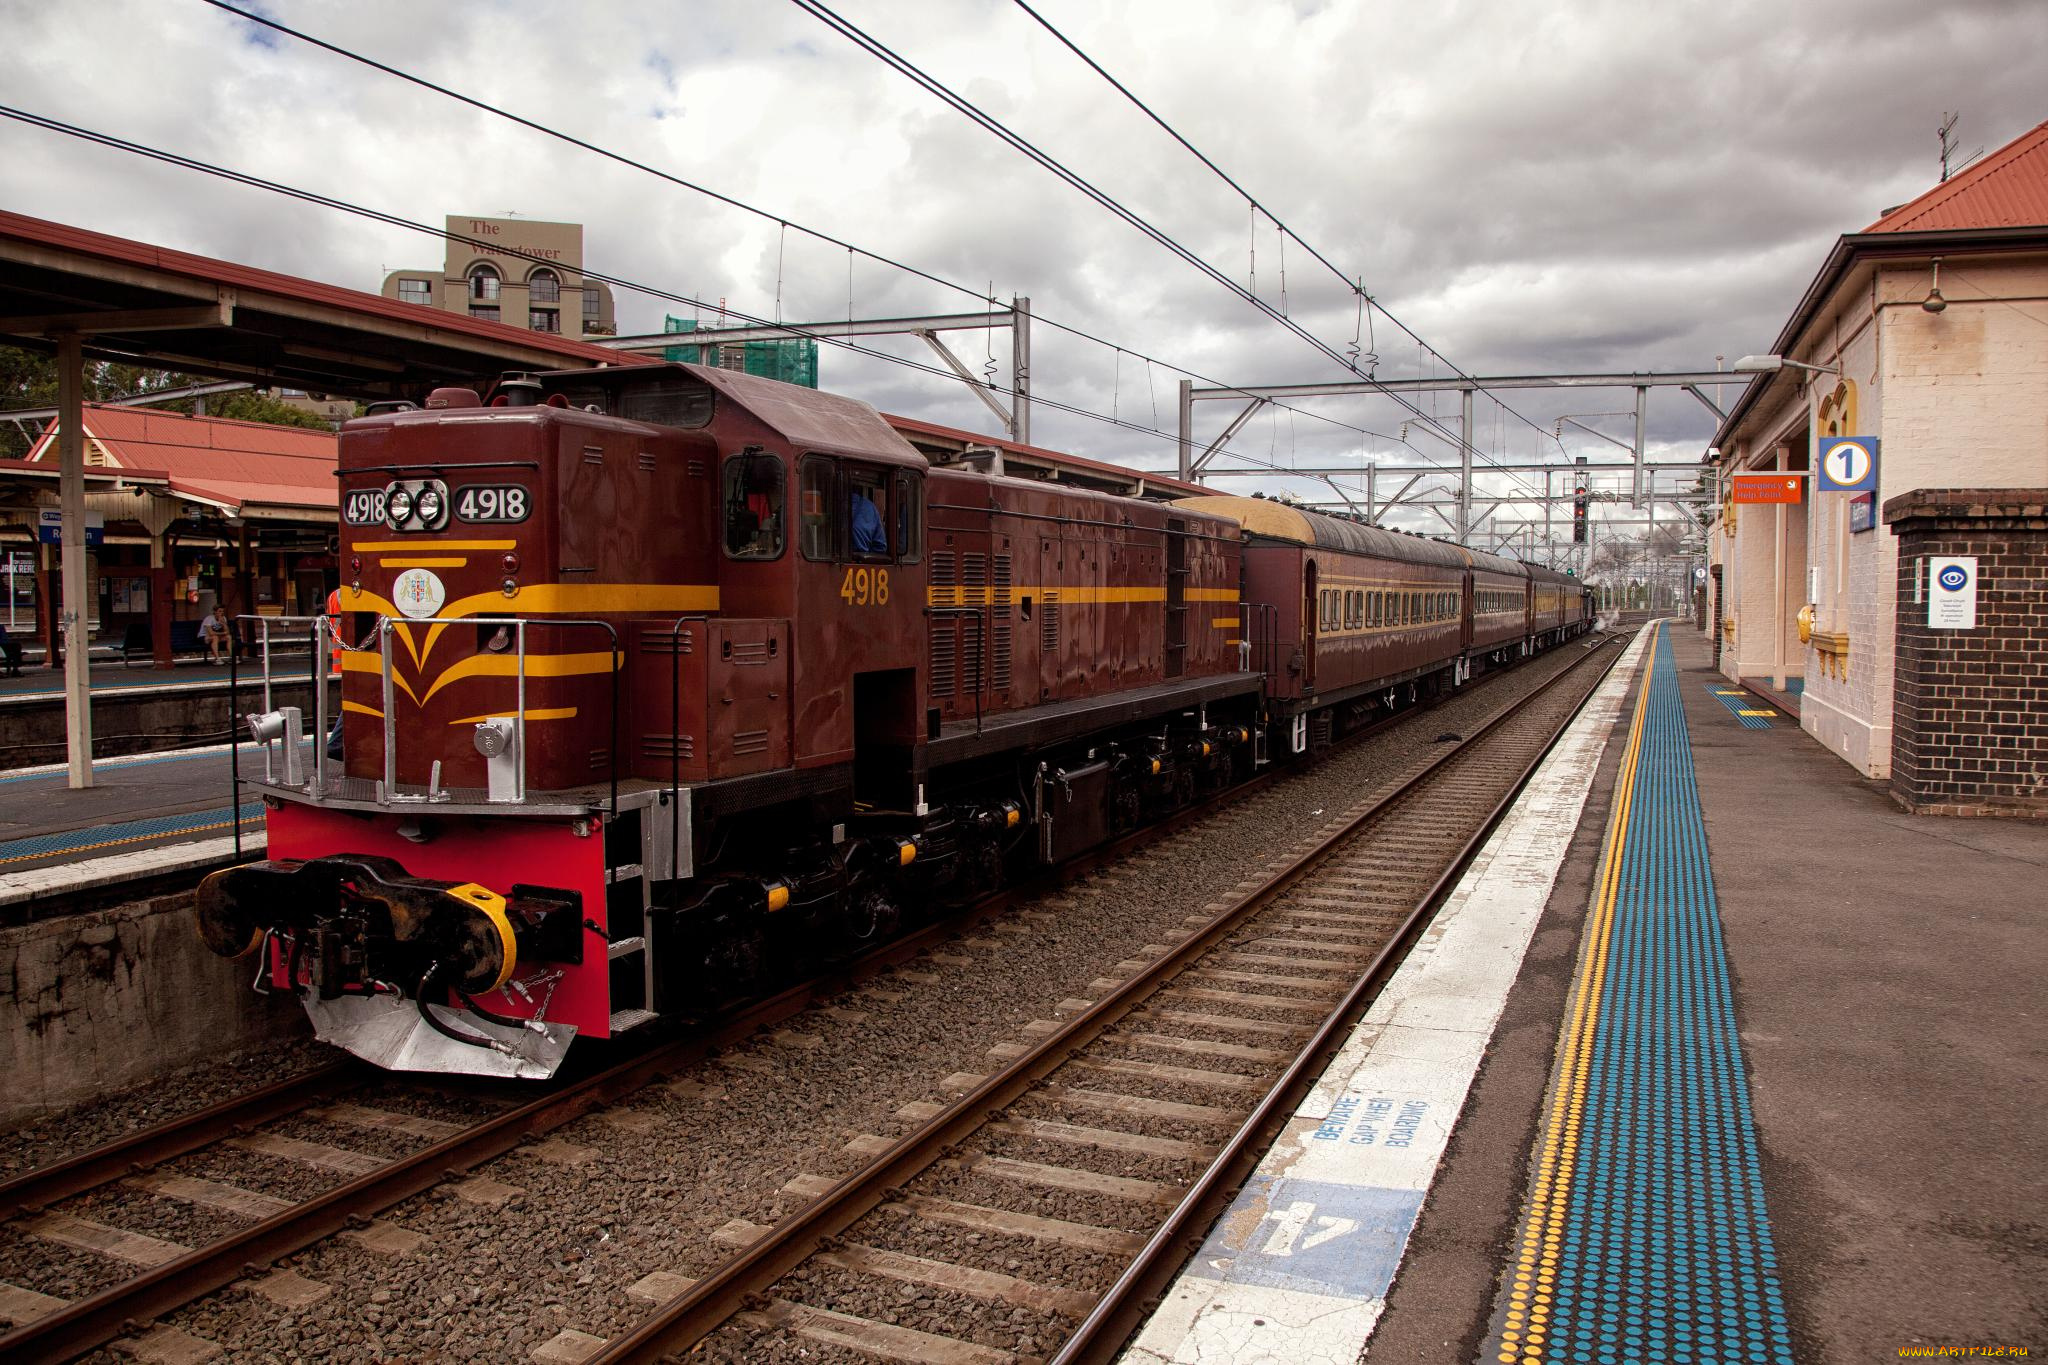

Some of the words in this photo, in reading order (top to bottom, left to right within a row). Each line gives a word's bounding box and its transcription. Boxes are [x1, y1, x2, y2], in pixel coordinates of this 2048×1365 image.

[470, 220, 500, 235] The
[1837, 448, 1853, 479] 1
[348, 493, 386, 522] 4918
[460, 489, 526, 519] 4918
[841, 568, 889, 606] 4918
[1313, 1098, 1361, 1141] BEWARE
[1348, 1124, 1379, 1145] GAP
[1384, 1100, 1429, 1148] BOARDING
